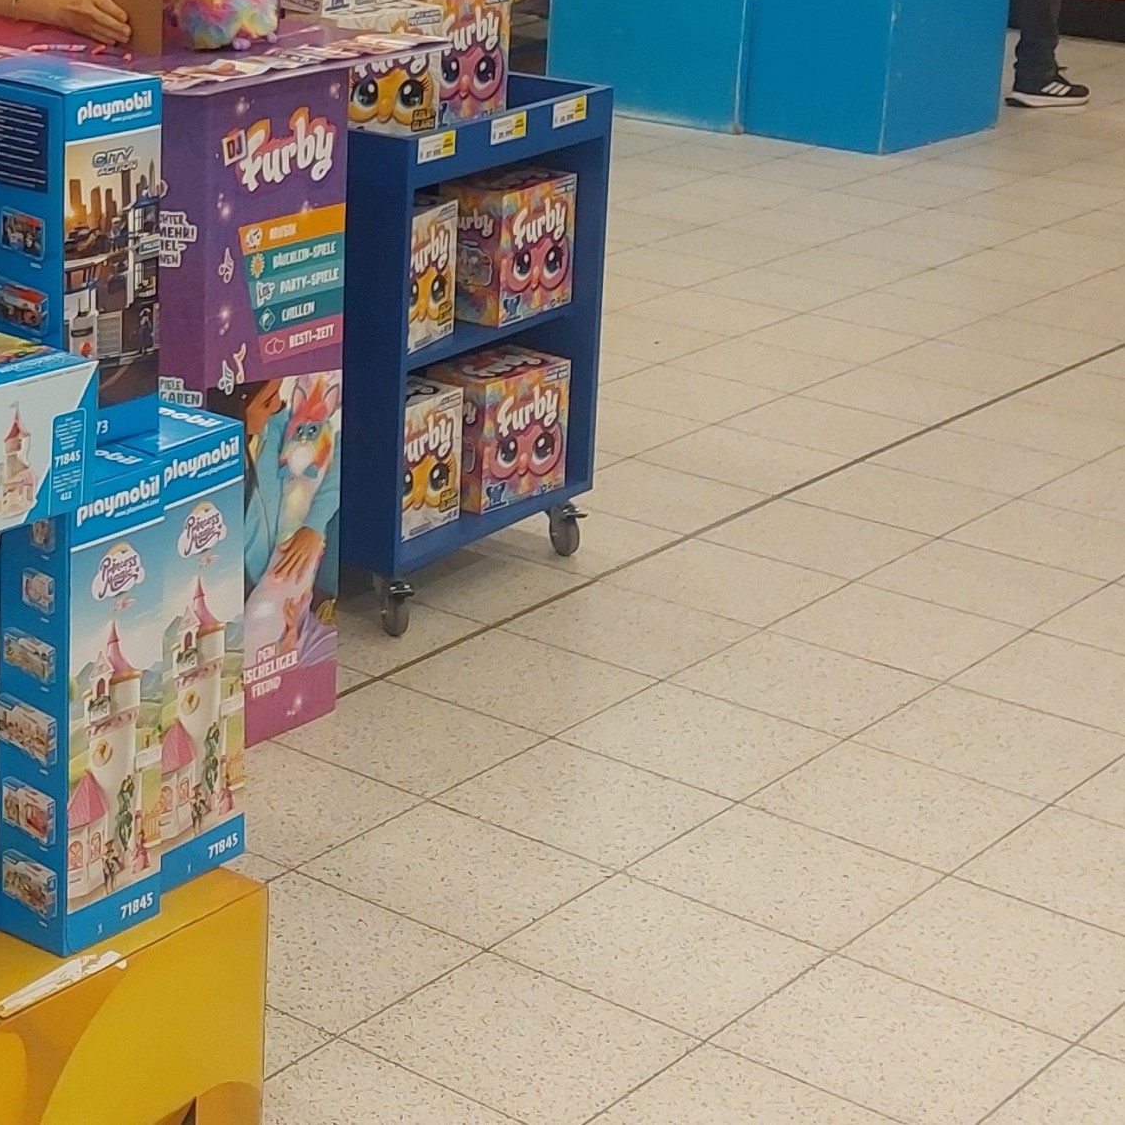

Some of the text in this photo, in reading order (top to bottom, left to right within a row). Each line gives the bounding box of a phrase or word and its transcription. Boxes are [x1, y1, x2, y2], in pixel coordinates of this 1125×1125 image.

[77, 90, 152, 126] playmobil
[93, 146, 133, 168] CITY
[97, 159, 138, 176] ACTION
[227, 116, 334, 193] DJ Furby
[513, 197, 566, 251] Furby
[280, 268, 340, 294] PARTY-SPIELE
[281, 302, 315, 322] CHILLEN
[289, 323, 335, 348] BESTI-ZEIT
[497, 384, 558, 437] Furby
[54, 450, 81, 468] 71845
[164, 436, 239, 489] playmobil
[77, 475, 160, 528] playmobil
[185, 513, 220, 536] Princess
[101, 555, 138, 577] Princess
[207, 832, 238, 860] 71845
[120, 892, 154, 921] 71845
